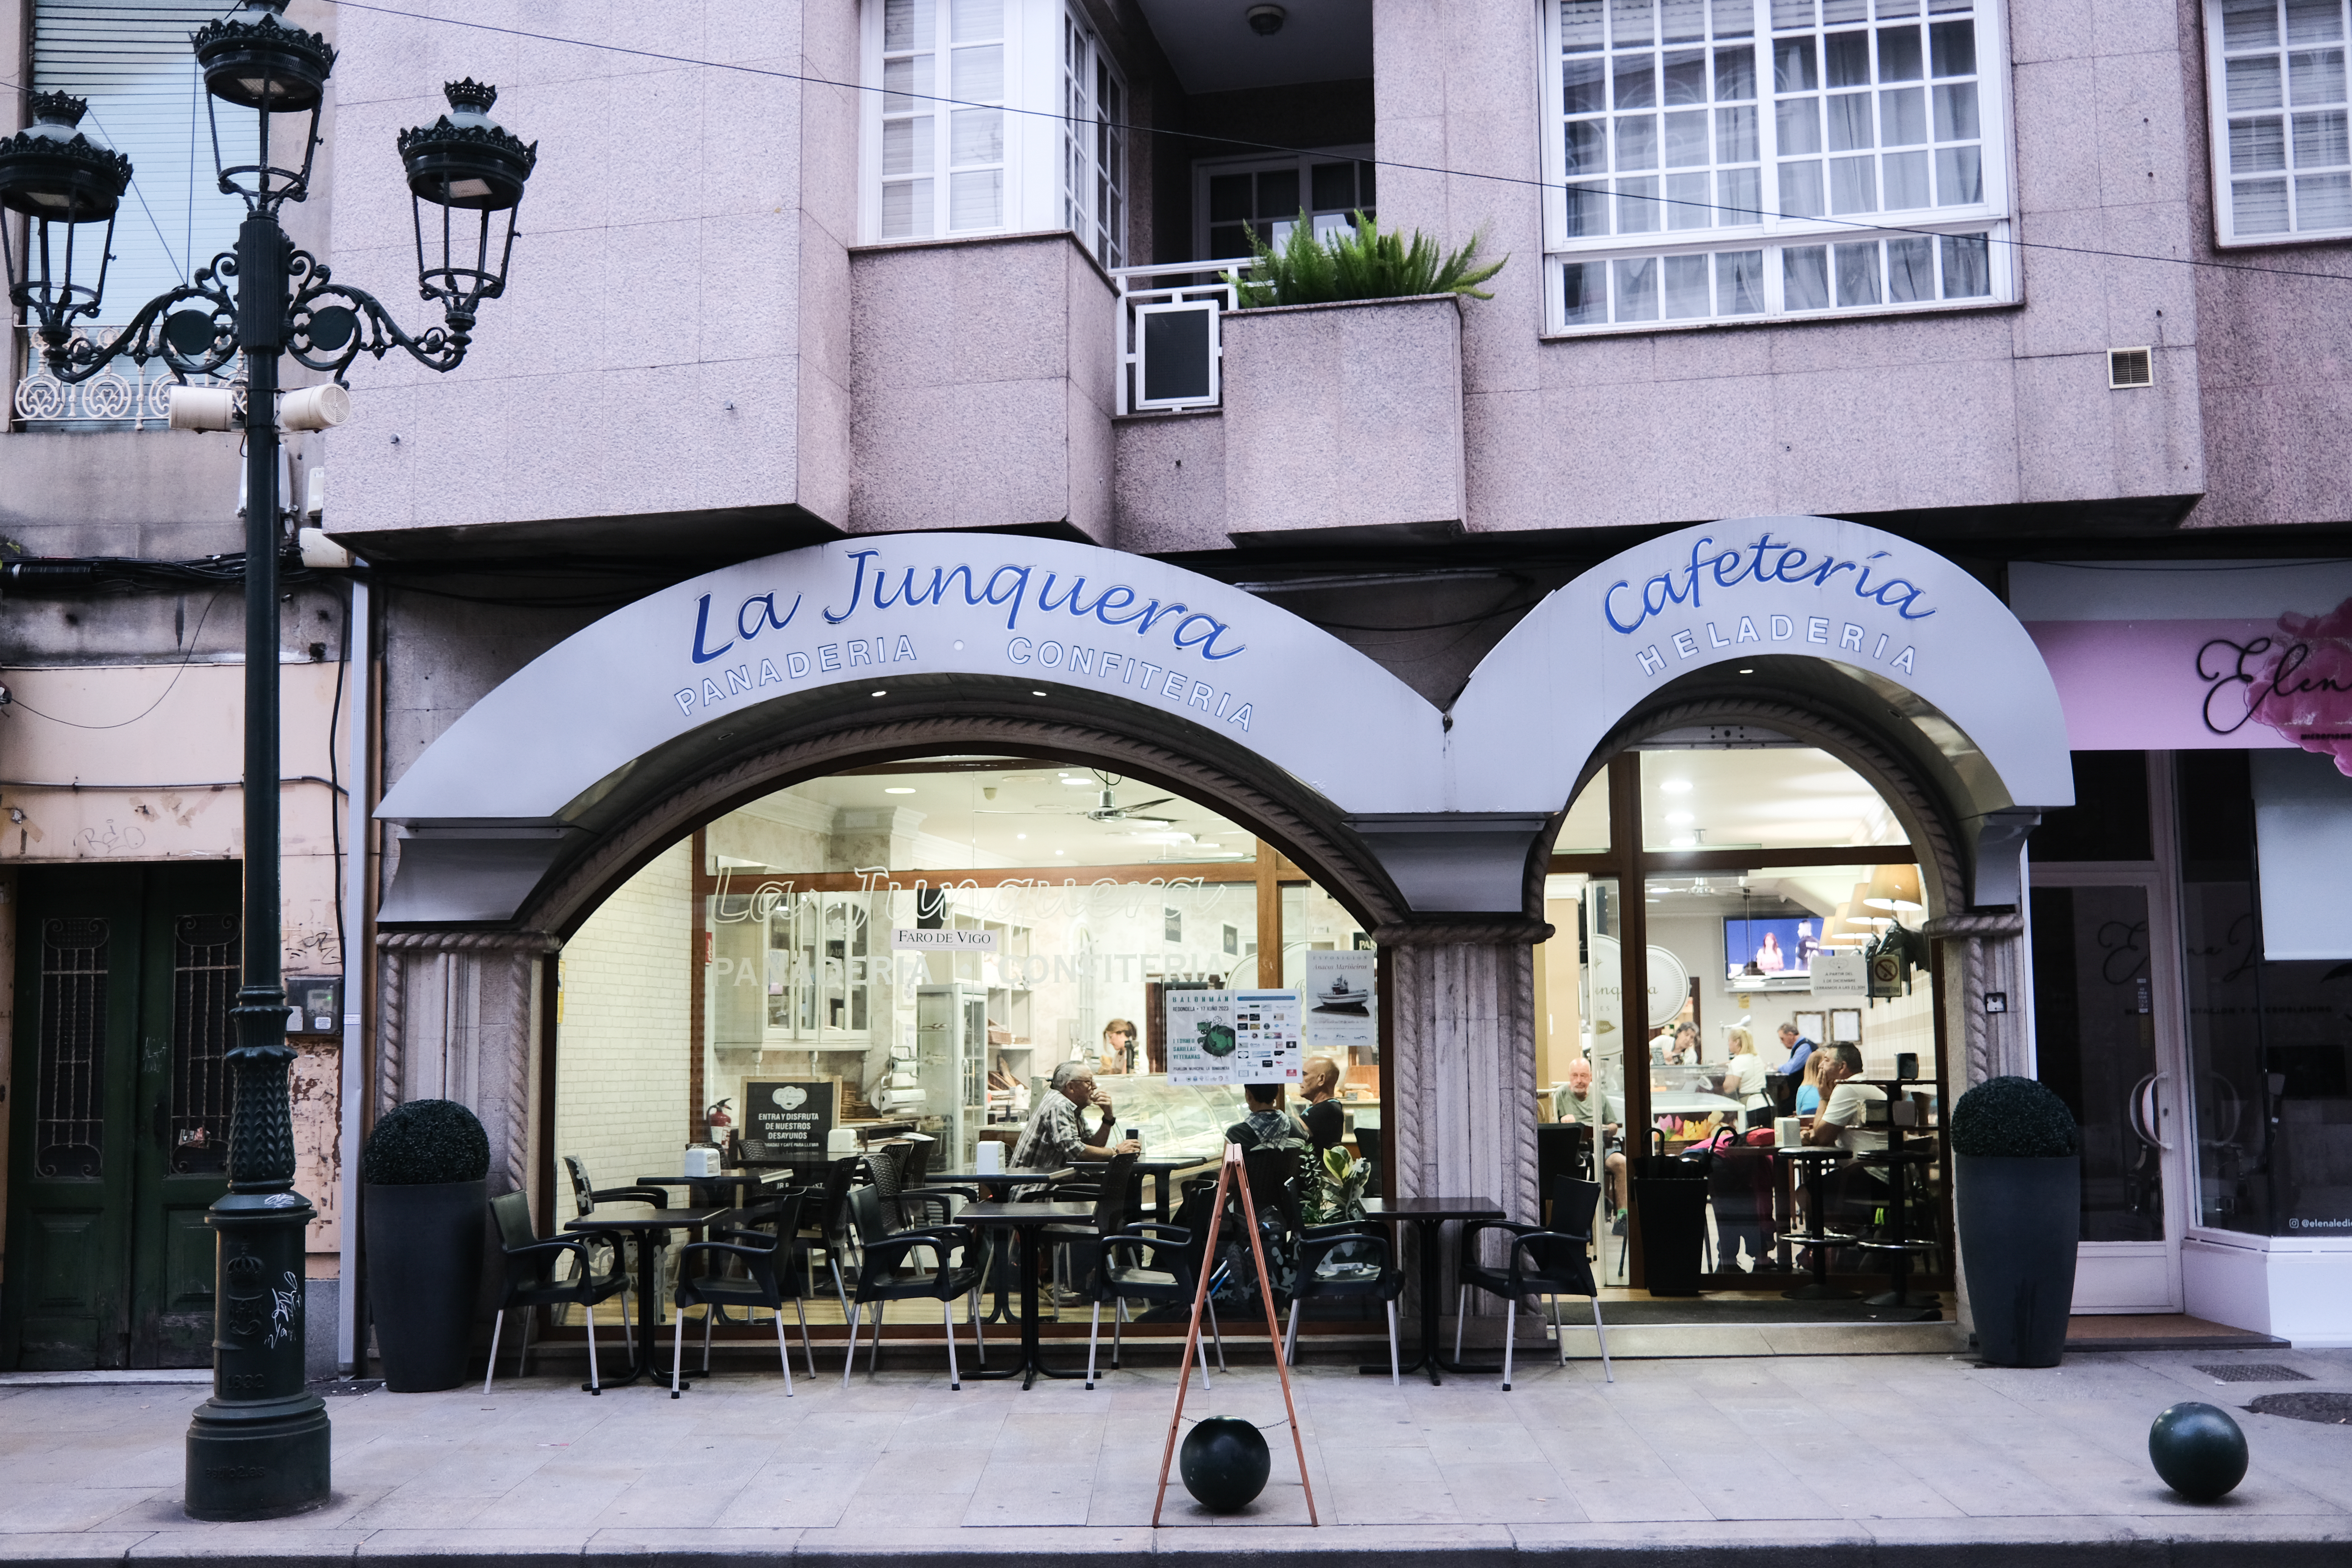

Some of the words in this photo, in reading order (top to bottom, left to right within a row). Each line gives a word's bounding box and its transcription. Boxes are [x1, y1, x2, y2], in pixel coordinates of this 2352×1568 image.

[691, 589, 803, 665] La
[822, 548, 1247, 662] Junquera
[1604, 532, 1937, 634] Cafetería
[1636, 615, 1915, 677] HELADERIA
[674, 635, 916, 716] PANADERIA
[1007, 637, 1253, 732] CONFITERIA
[713, 865, 818, 923] La
[832, 866, 1227, 940] Junquera
[711, 955, 934, 986] PANADERIA
[998, 953, 1227, 984] CONFITERIA
[899, 930, 933, 943] FARO
[936, 933, 953, 943] DE
[957, 931, 990, 944] VIGO
[2301, 1218, 2352, 1228] @elenaledi
